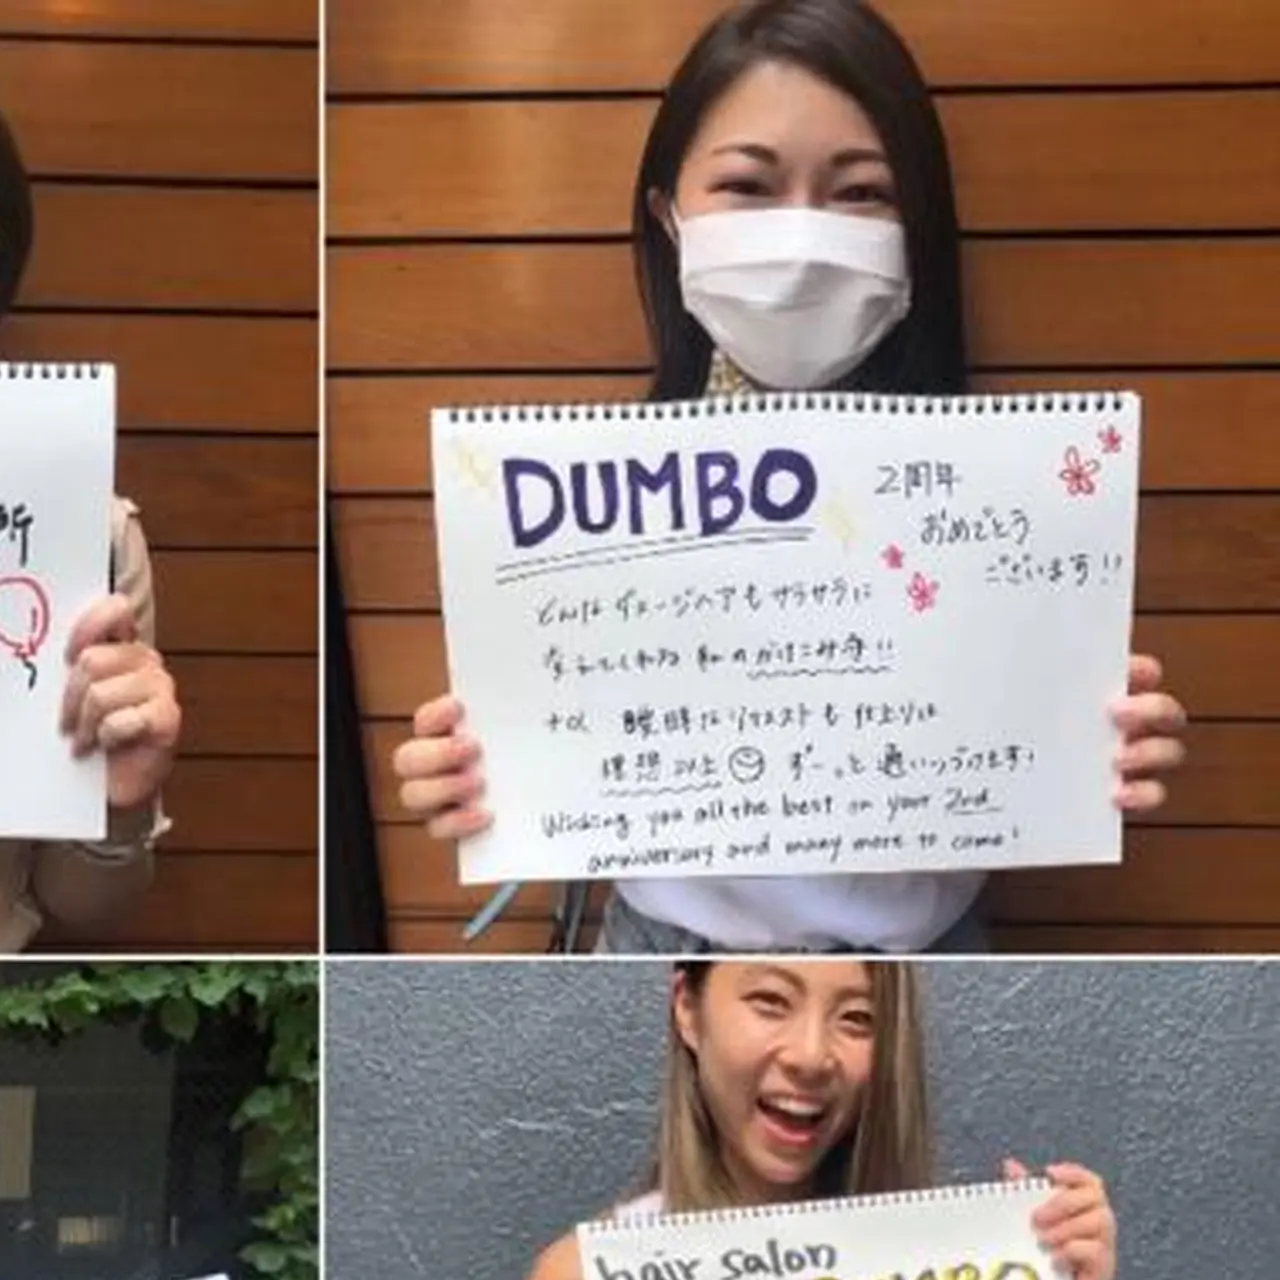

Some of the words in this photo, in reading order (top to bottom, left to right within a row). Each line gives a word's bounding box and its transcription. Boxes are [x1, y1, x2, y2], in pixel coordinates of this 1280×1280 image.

[872, 460, 964, 498] 2周年
[501, 447, 820, 550] DUMBO
[920, 510, 1033, 545] おめでとう
[647, 807, 683, 834] you
[781, 794, 834, 818] best
[726, 834, 771, 858] and
